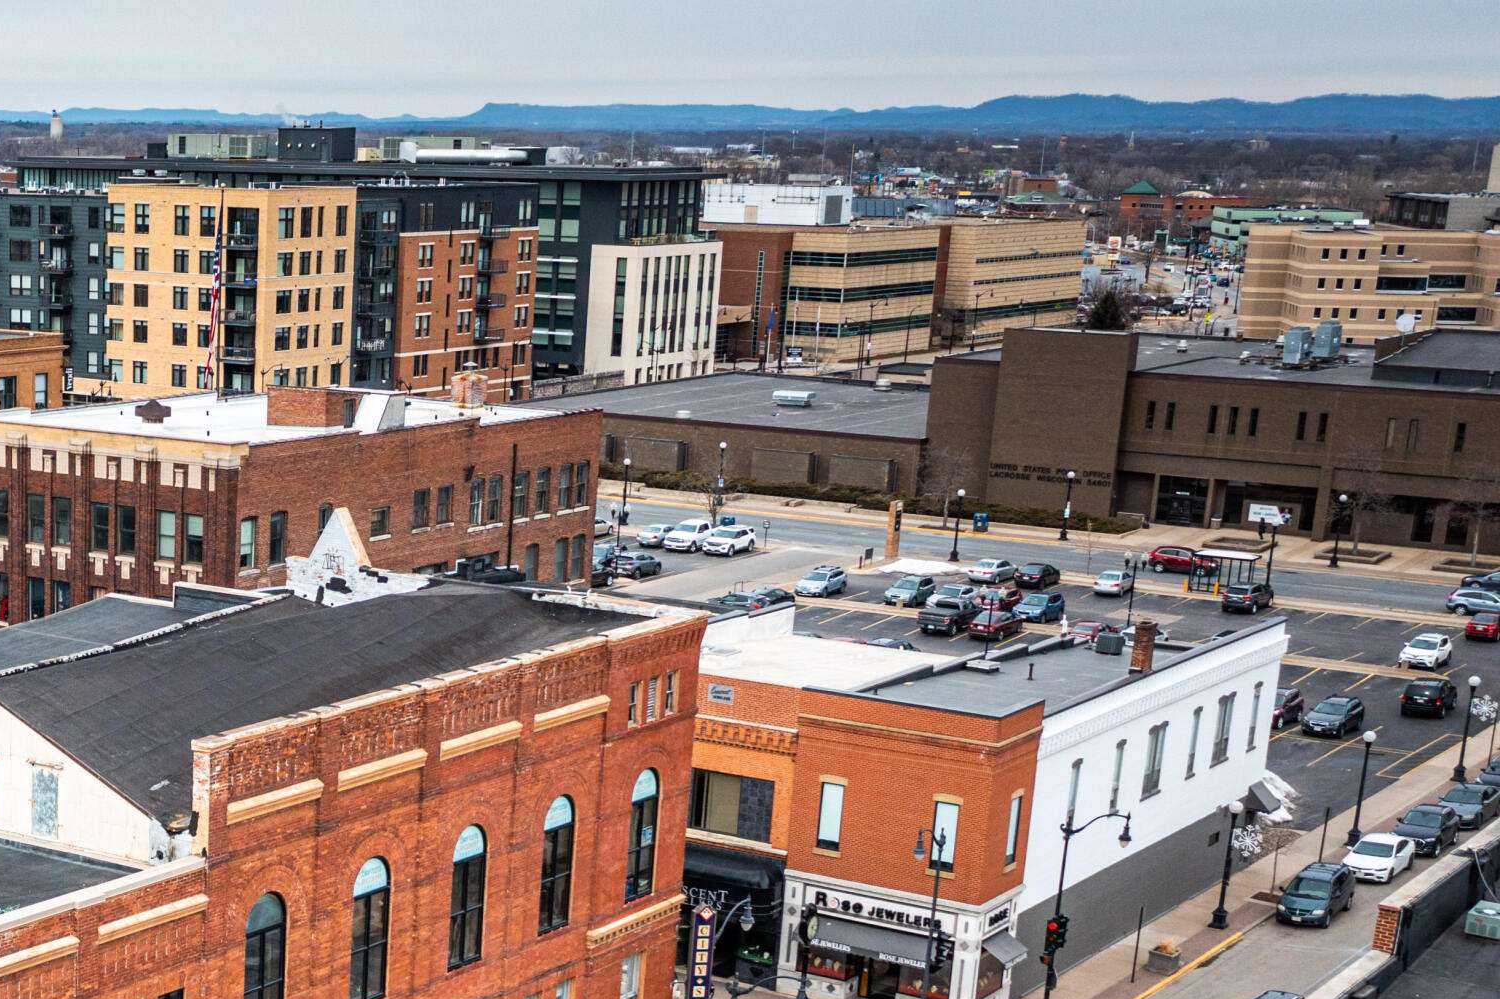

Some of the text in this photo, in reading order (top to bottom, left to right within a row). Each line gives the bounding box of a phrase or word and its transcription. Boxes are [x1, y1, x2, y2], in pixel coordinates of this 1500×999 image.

[990, 463, 1018, 472] UNITED
[1022, 465, 1051, 474] STATES
[1083, 471, 1112, 480] OFFICE
[1036, 475, 1082, 485] WISCOIN
[682, 885, 729, 903] SCENT
[696, 925, 709, 976] CITY
[879, 952, 926, 969] ROSE JEWELER
